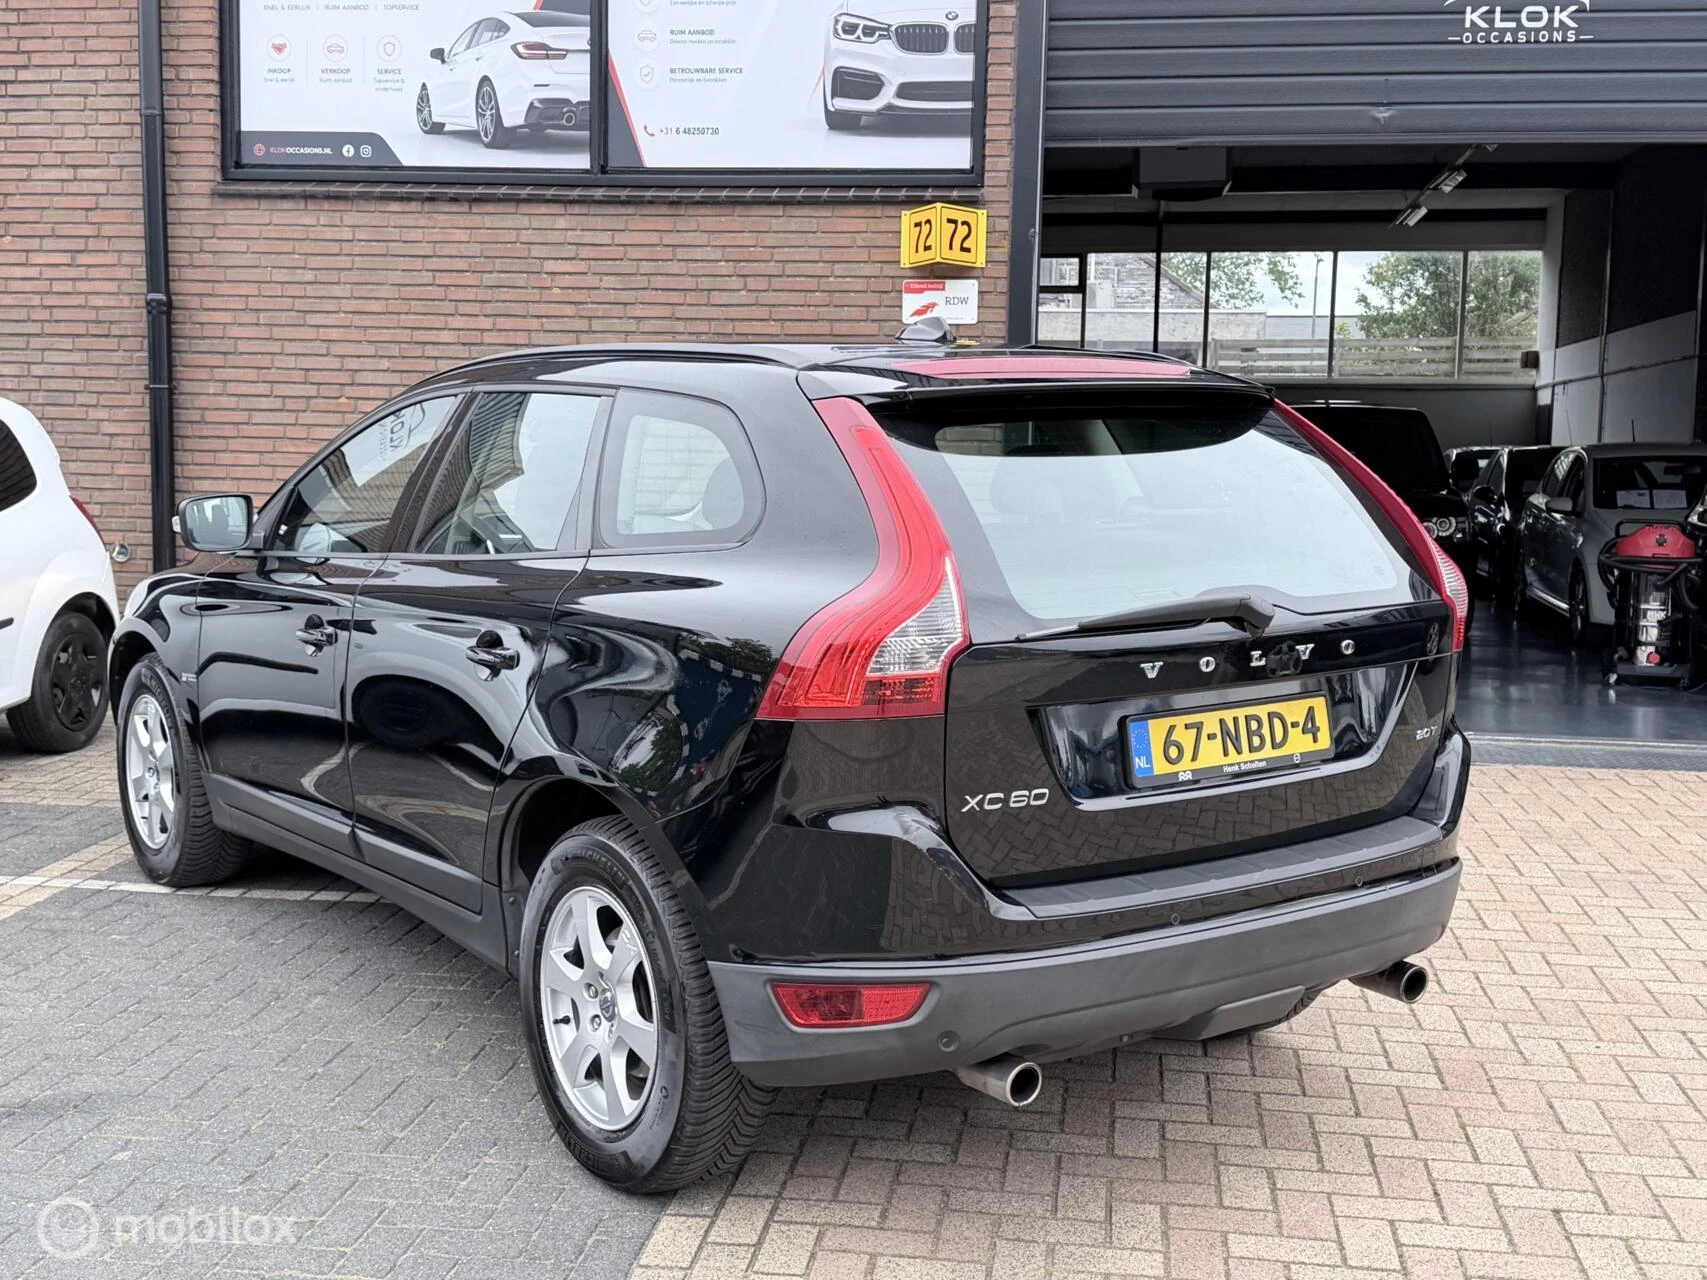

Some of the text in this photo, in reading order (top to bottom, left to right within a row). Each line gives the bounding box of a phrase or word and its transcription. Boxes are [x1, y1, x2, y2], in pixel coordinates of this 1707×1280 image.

[1464, 5, 1580, 28] KLOK
[1462, 30, 1576, 44] OCCASIONS
[659, 127, 720, 136] +31 6 48250730
[270, 146, 333, 155] KLOKOCCASIONS.NL
[913, 218, 933, 254] 72
[946, 217, 972, 254] 72
[944, 296, 970, 306] RDW
[1139, 638, 1356, 679] VOLVO
[1162, 705, 1321, 766] 67-NBD-4
[1135, 755, 1151, 770] NL
[1222, 760, 1267, 773] Henk Scholten
[960, 788, 1050, 812] XC 60
